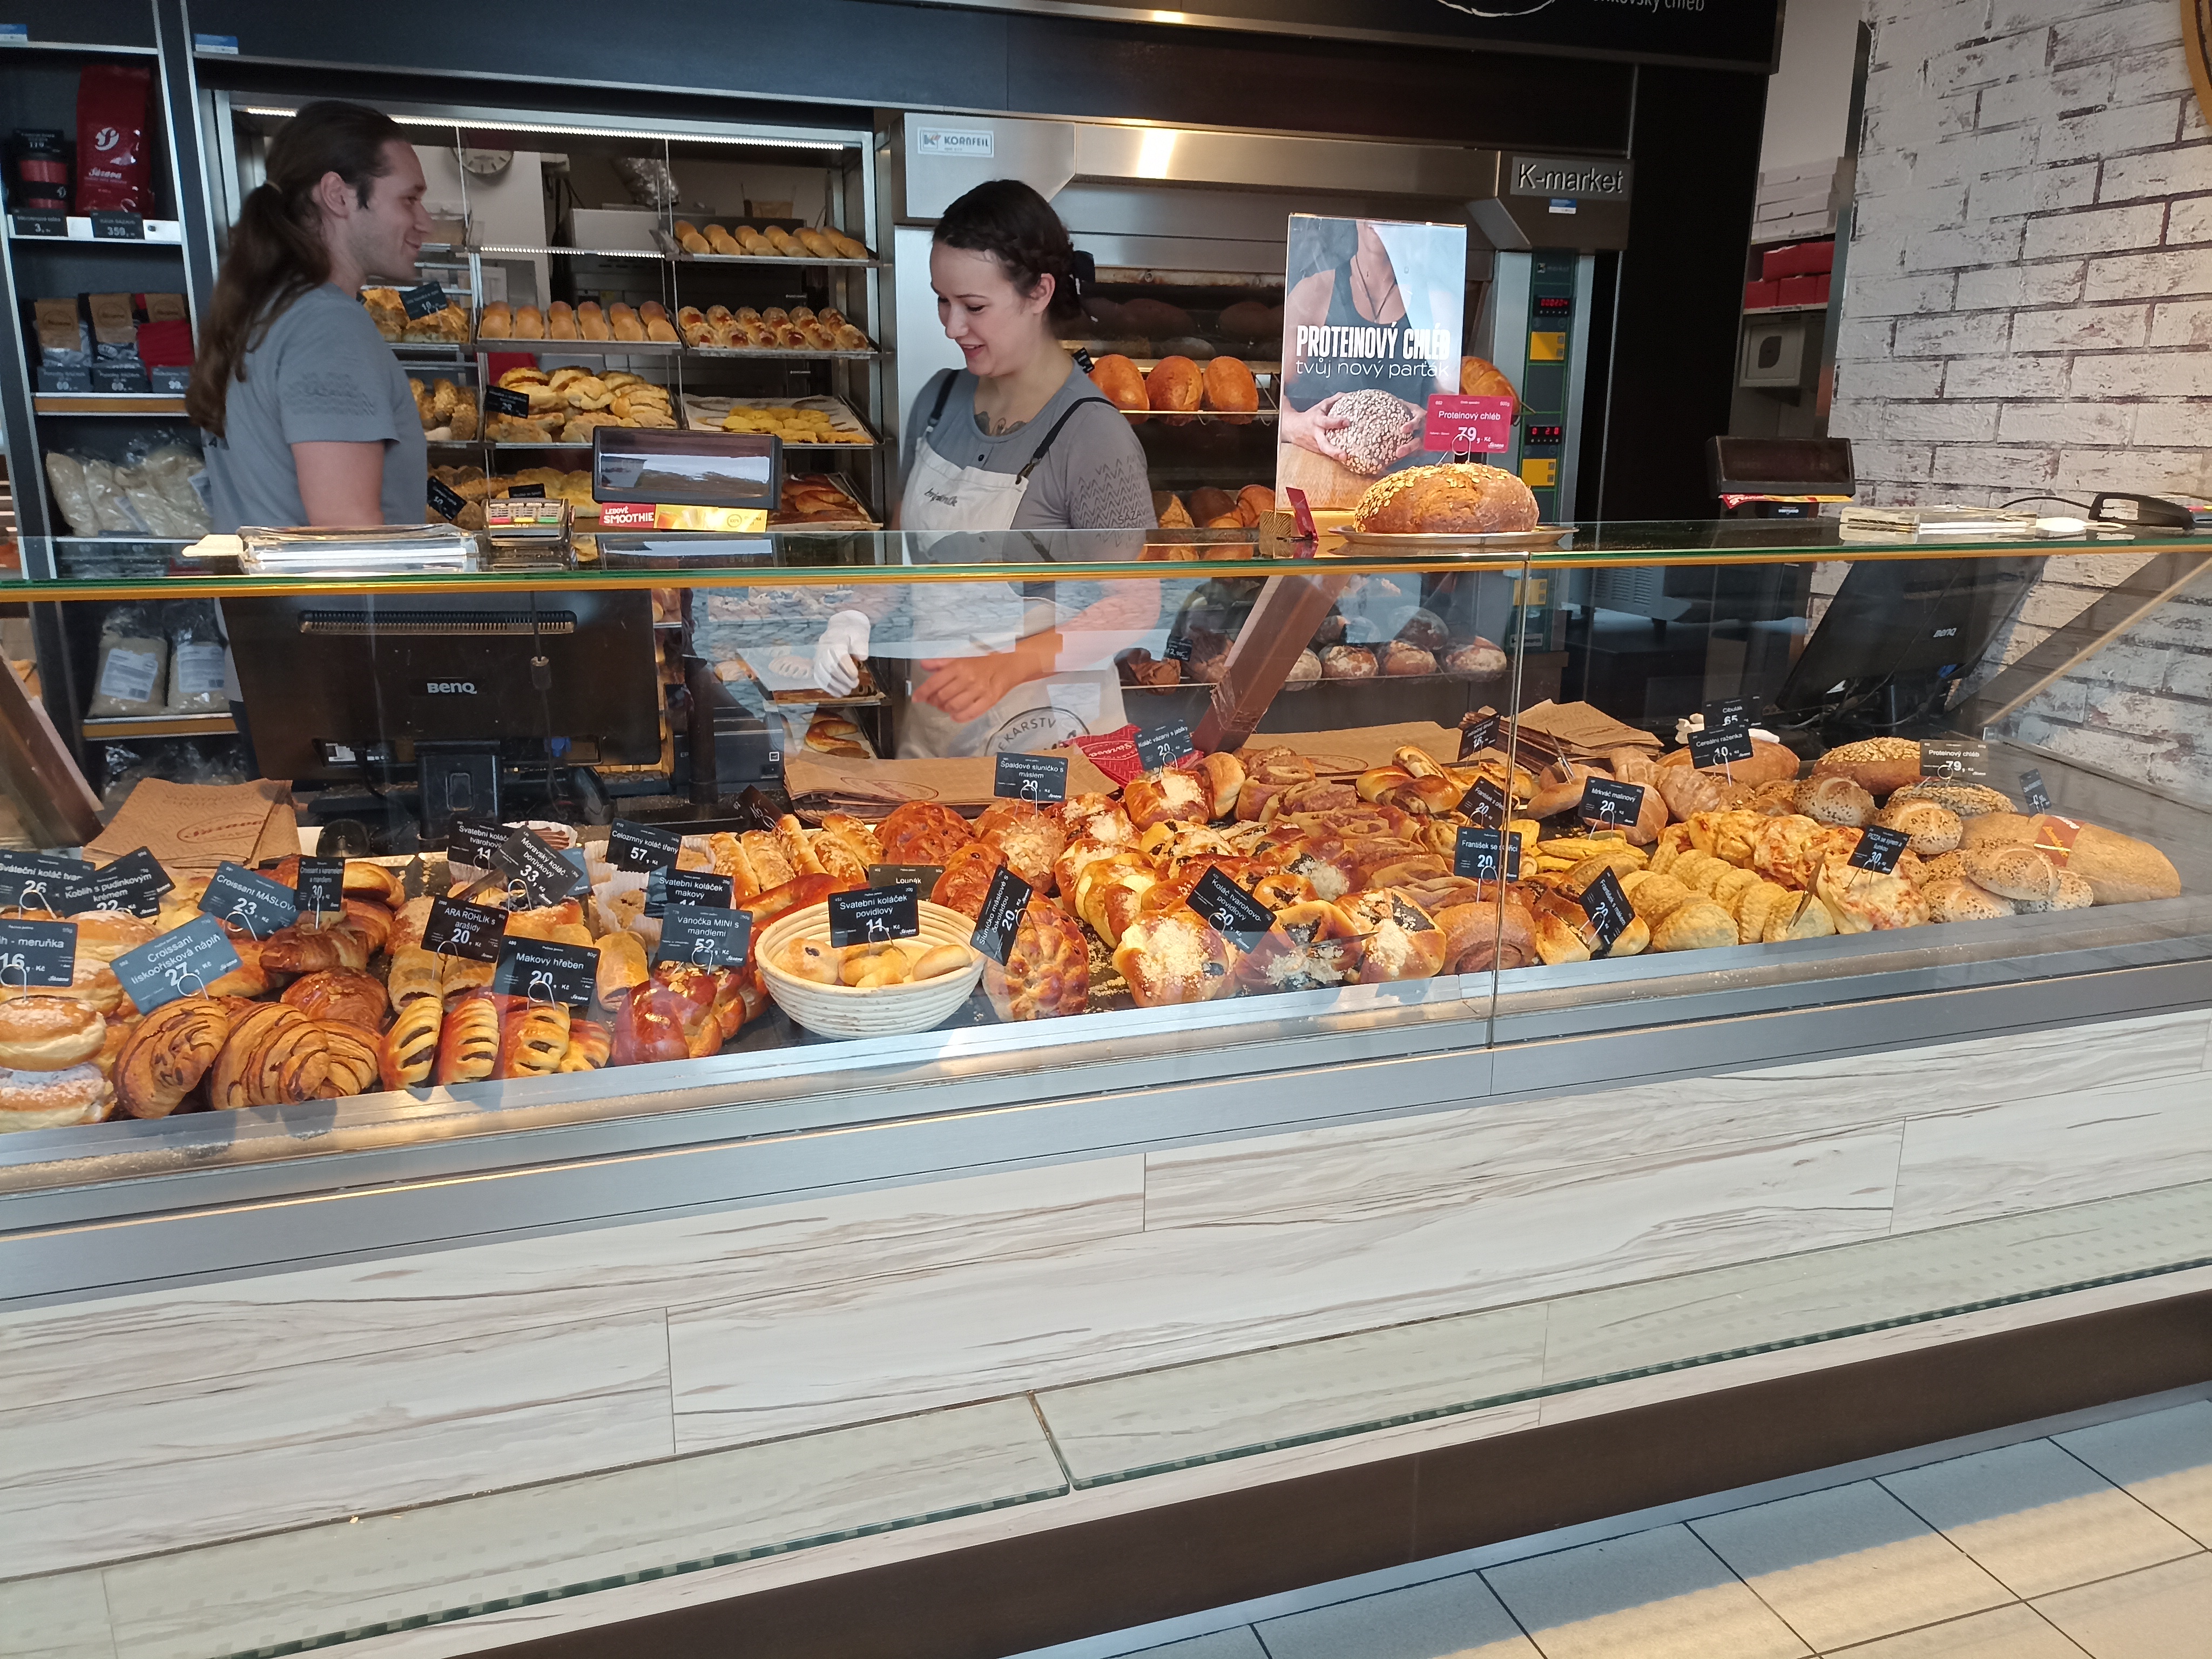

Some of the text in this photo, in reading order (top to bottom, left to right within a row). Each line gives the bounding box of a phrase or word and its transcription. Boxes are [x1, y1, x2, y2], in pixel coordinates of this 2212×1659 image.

[945, 136, 989, 147] KORNFEIL
[1518, 164, 1623, 193] K-market
[1296, 321, 1451, 360] PROTEINOVÝ CHLÉB
[1296, 358, 1449, 379] tvůj nový parťák
[1438, 411, 1501, 421] Proteinový chléb
[604, 512, 654, 524] SMOOTHIE
[605, 505, 629, 514] LEDOVÉ
[459, 825, 488, 837] Svatební
[644, 839, 662, 849] koláč
[1461, 840, 1489, 849] František
[521, 837, 551, 863] Moravský
[548, 859, 567, 876] koláč
[522, 852, 555, 878] borůvkový
[101, 873, 152, 892] pudinkovým
[217, 874, 255, 896] Croissant
[659, 876, 723, 892] Svatební koláček
[1211, 878, 1230, 896] Koláč
[675, 889, 705, 899] makový
[840, 894, 908, 911] Svatební koláček
[444, 907, 461, 918] ARA
[462, 911, 490, 924] ROHLÍK
[855, 906, 894, 919] povidlový
[979, 912, 995, 945] Sluníčko
[992, 881, 1007, 913] máslové
[991, 895, 1009, 933] čokoládou
[1216, 895, 1247, 921] povidlový
[455, 921, 481, 933] arašídy
[677, 916, 712, 926] Vánočka
[713, 919, 732, 927] MINI
[687, 928, 726, 937] mandlemi
[18, 939, 64, 948] meruňka
[147, 935, 193, 962] Croissant
[194, 934, 221, 953] náplň
[202, 961, 212, 969] Kč
[516, 952, 584, 970] Makový hřeben
